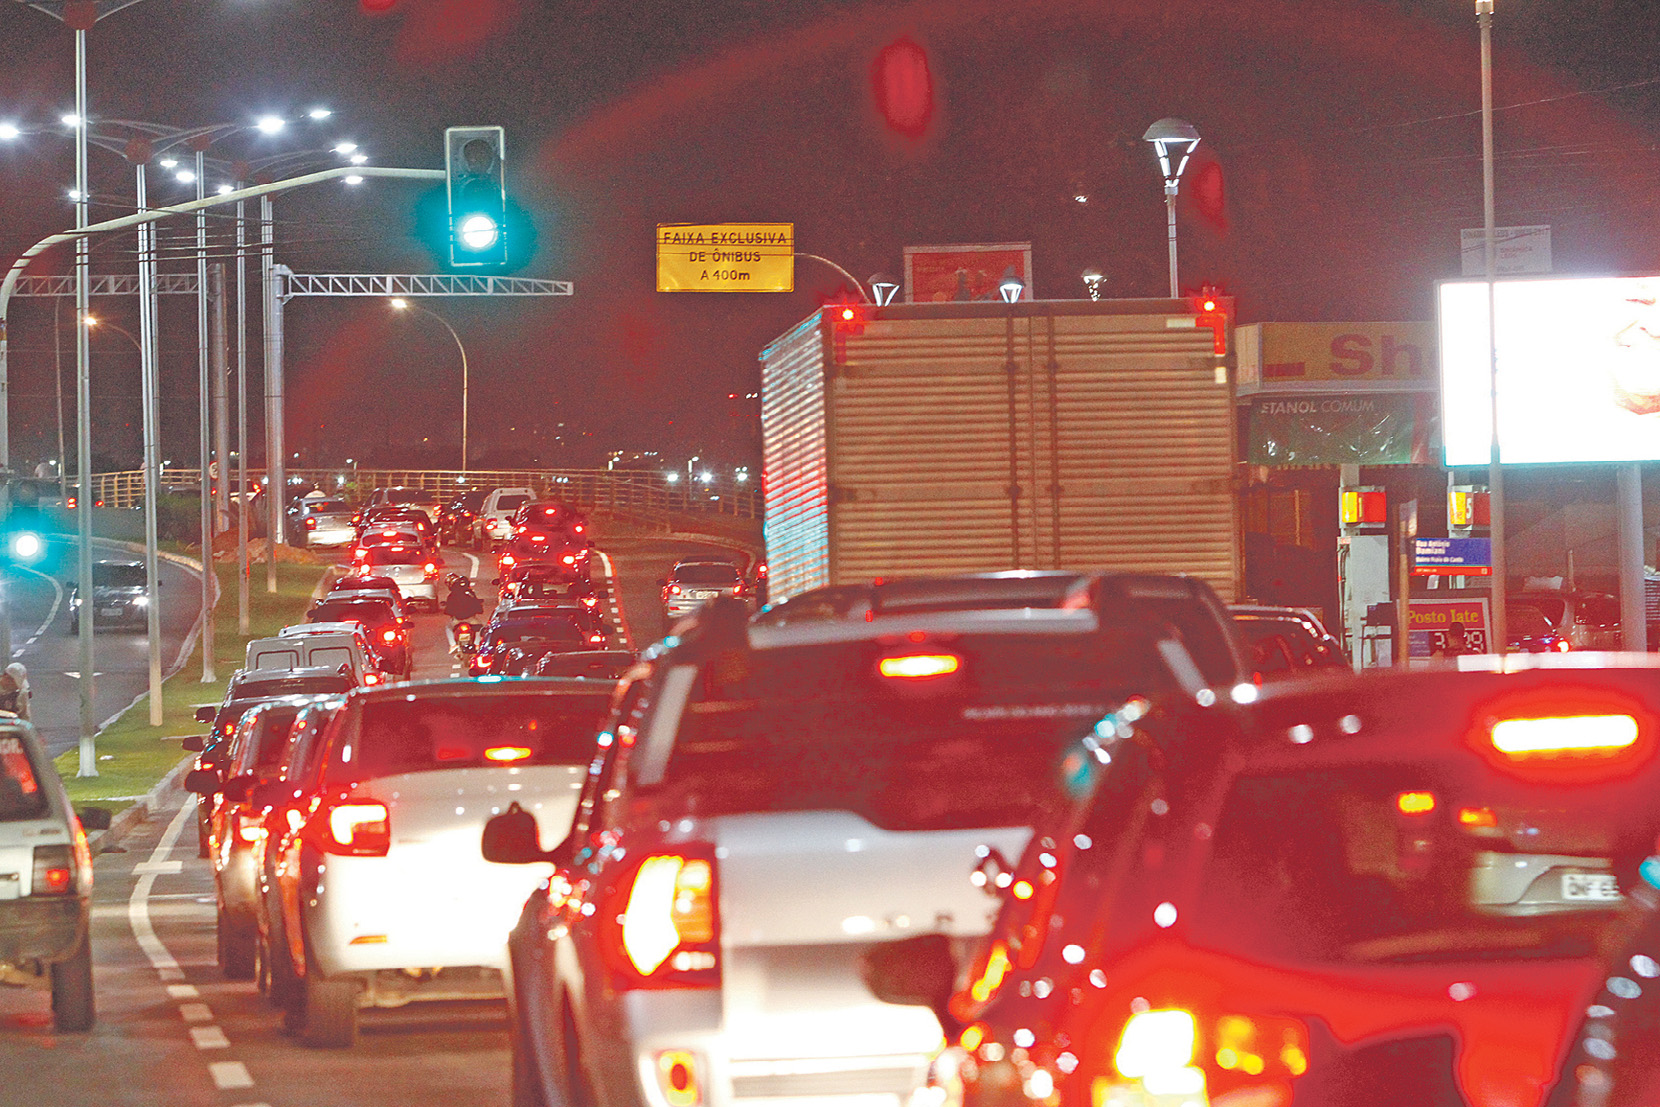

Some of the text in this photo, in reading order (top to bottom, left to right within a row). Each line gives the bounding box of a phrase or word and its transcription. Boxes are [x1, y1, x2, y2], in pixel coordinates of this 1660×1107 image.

[663, 232, 787, 244] FAIXA EXCLUSIVA
[689, 248, 761, 262] DE ÔNIBUS
[700, 269, 750, 280] A 400m
[1261, 399, 1375, 415] ETANOL COMUM
[1466, 498, 1473, 519] 5
[1408, 610, 1446, 624] Posto
